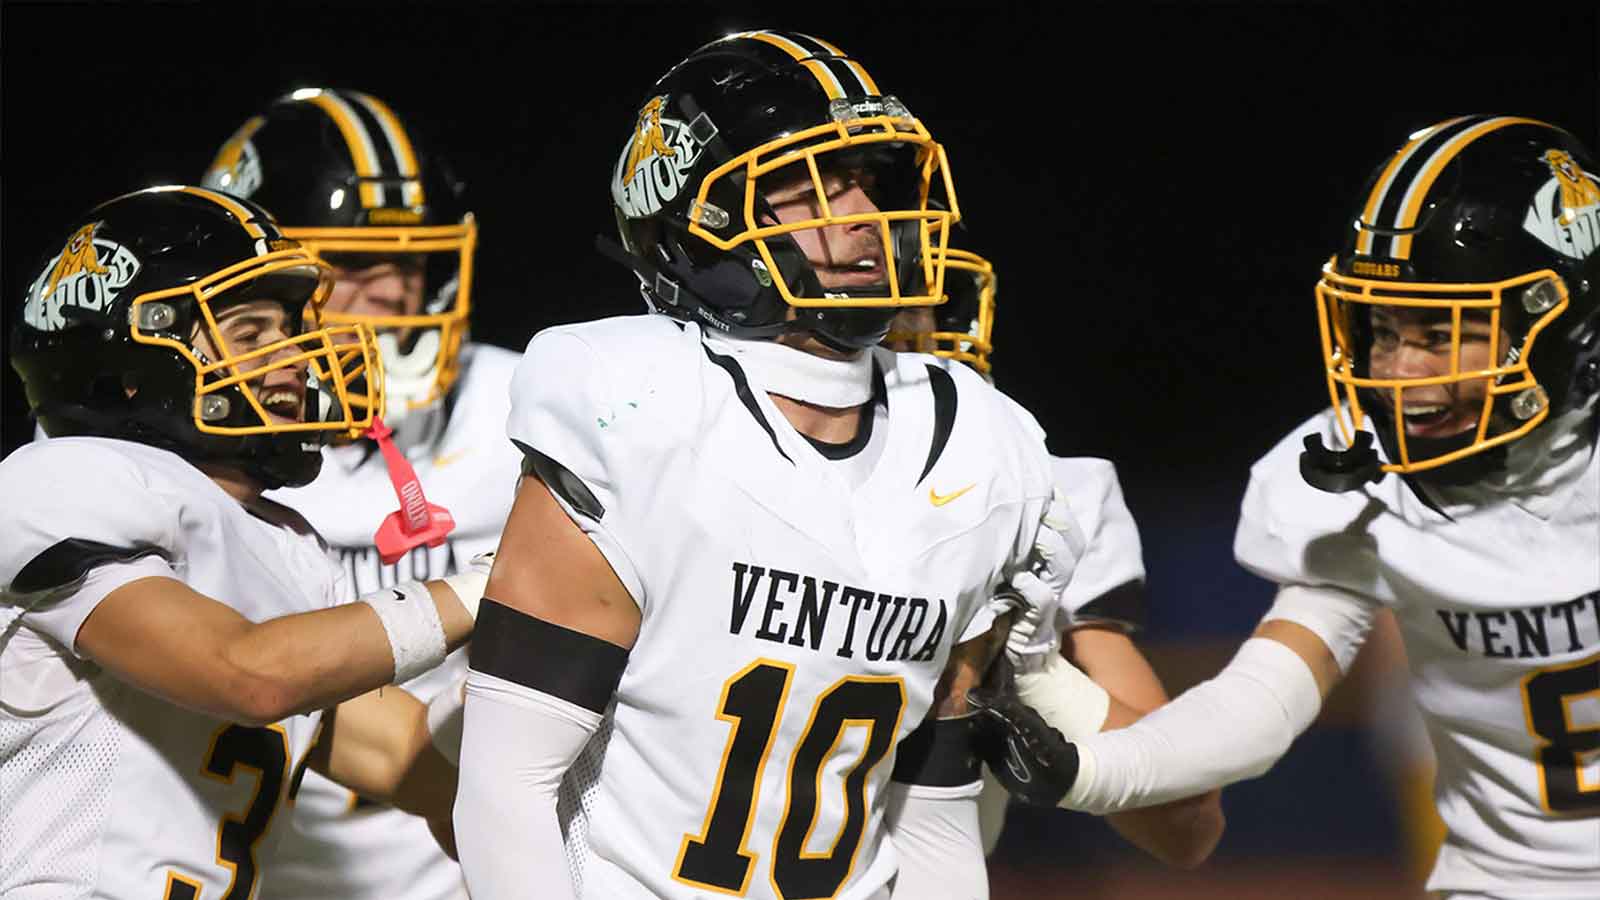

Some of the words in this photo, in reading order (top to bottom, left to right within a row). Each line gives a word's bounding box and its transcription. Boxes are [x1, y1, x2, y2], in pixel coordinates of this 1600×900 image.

[730, 561, 948, 663] VENTURA
[1437, 590, 1600, 658] VENT
[163, 719, 322, 900] 3
[671, 657, 907, 900] 10
